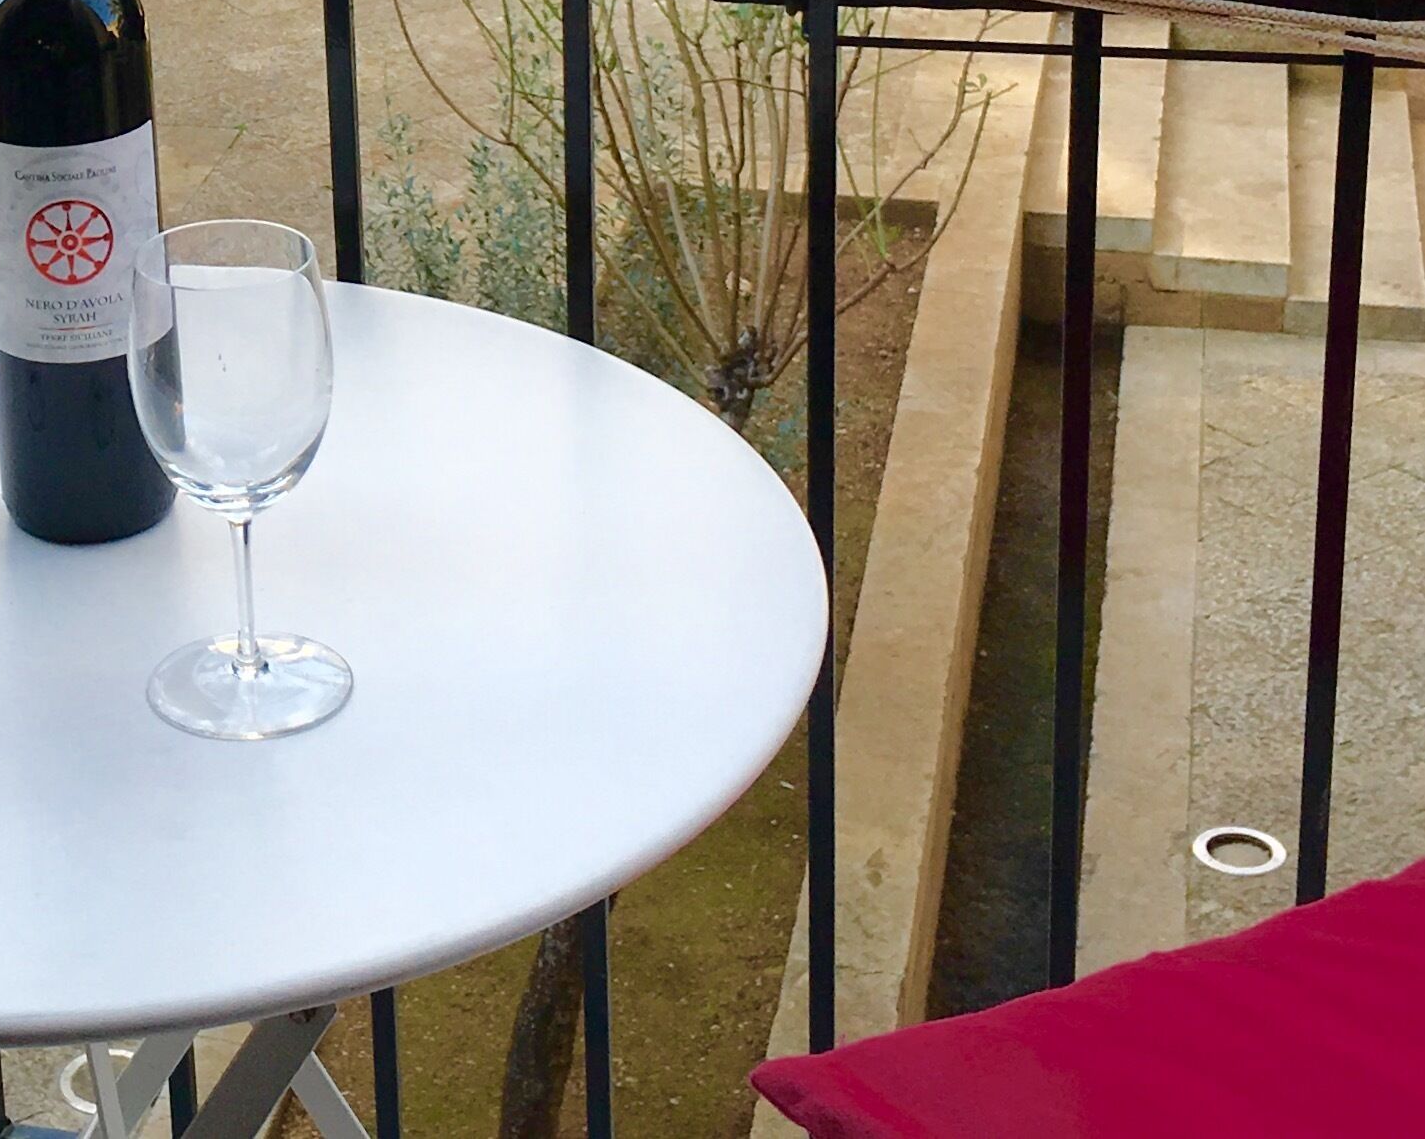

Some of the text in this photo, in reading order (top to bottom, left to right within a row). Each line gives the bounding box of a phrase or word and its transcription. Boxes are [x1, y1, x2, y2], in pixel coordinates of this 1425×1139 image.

[25, 292, 124, 310] NERO D'AVOLA
[53, 311, 96, 324] SYRAH
